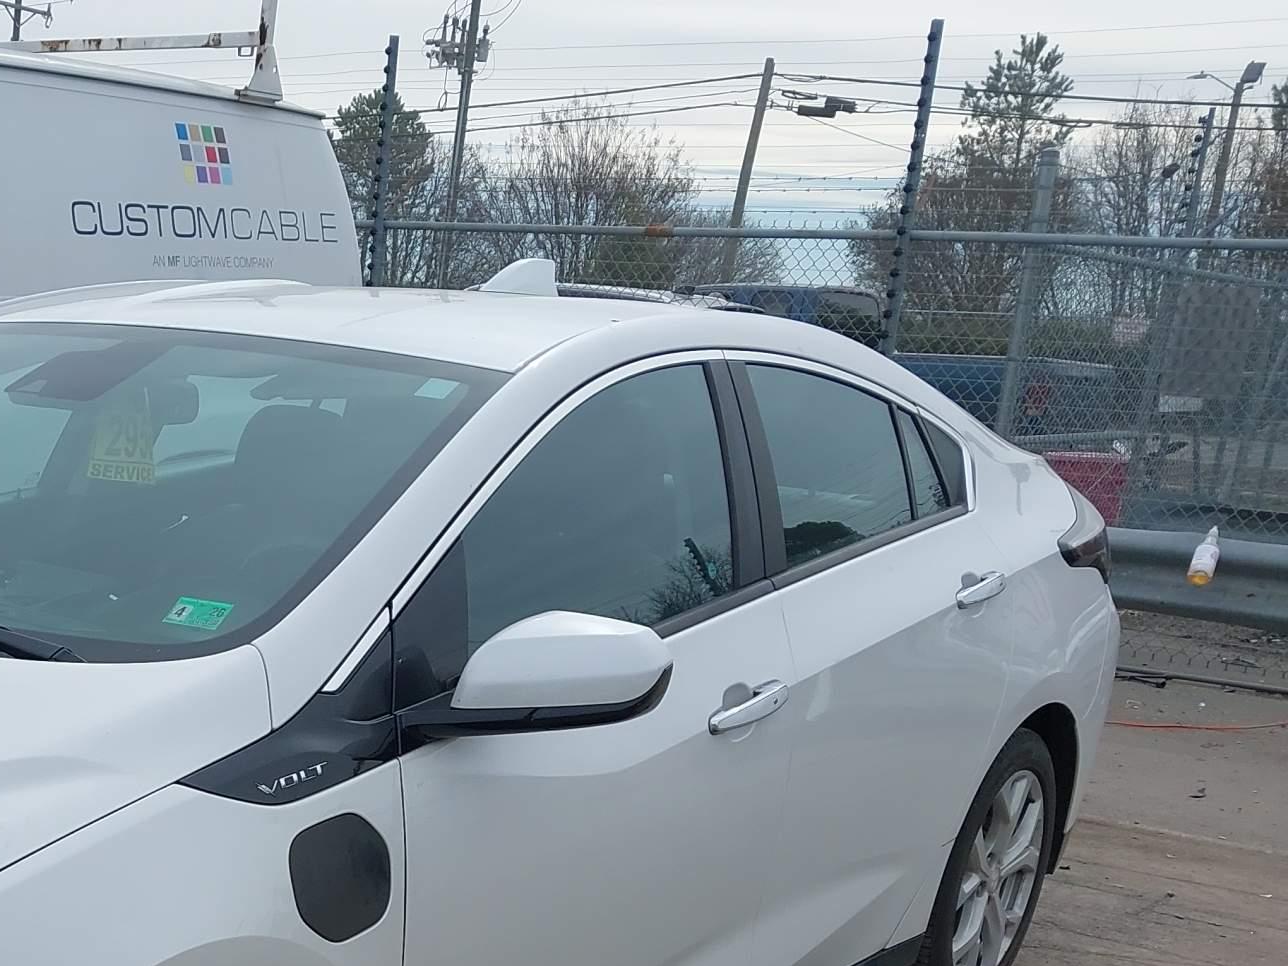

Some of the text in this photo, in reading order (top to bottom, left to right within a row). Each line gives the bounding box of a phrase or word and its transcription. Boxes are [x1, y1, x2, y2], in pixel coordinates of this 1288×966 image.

[71, 200, 339, 243] CUSTOMCABLE
[152, 255, 274, 269] AN MF LIGHTWAVE COMPANY
[90, 463, 153, 482] SERVICE
[174, 606, 227, 618] 4 26
[255, 761, 329, 796] VOLT
